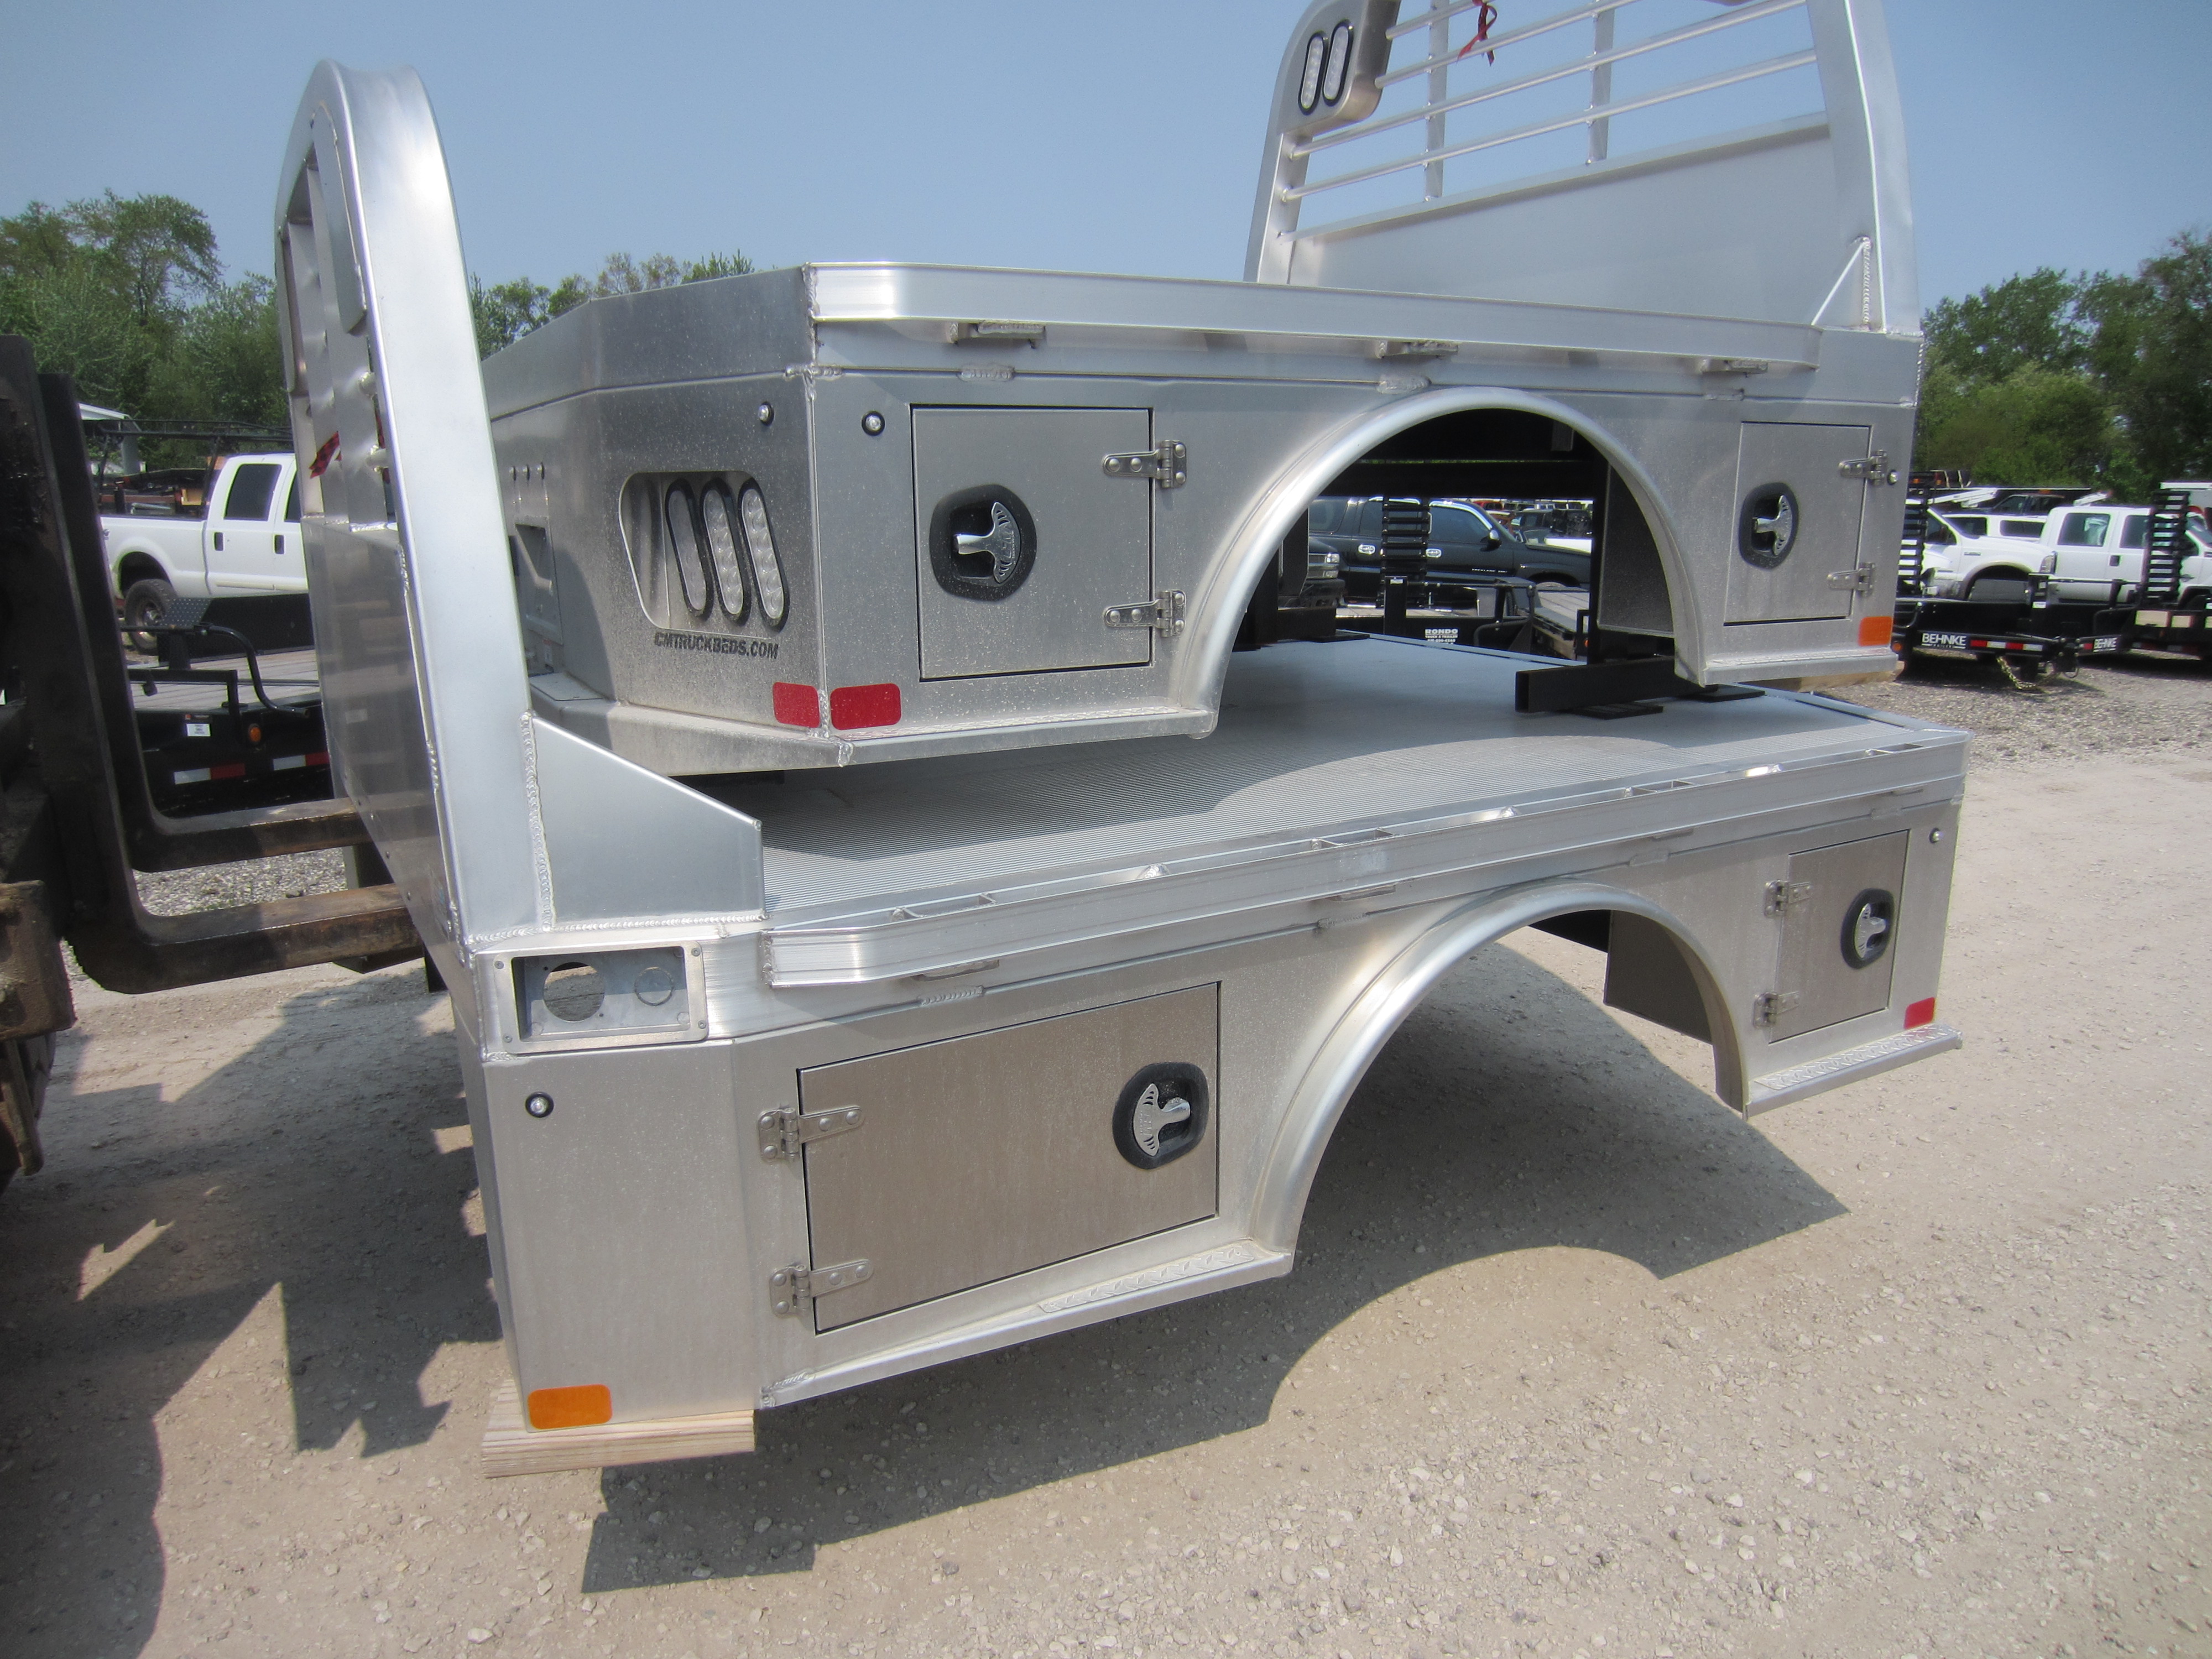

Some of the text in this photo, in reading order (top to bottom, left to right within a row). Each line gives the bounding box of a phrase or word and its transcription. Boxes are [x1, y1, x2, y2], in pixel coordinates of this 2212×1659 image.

[654, 632, 779, 659] CMTRUCKBEDS.COM
[1922, 633, 1967, 646] BEHNKE
[2094, 637, 2117, 649] BEHNKE
